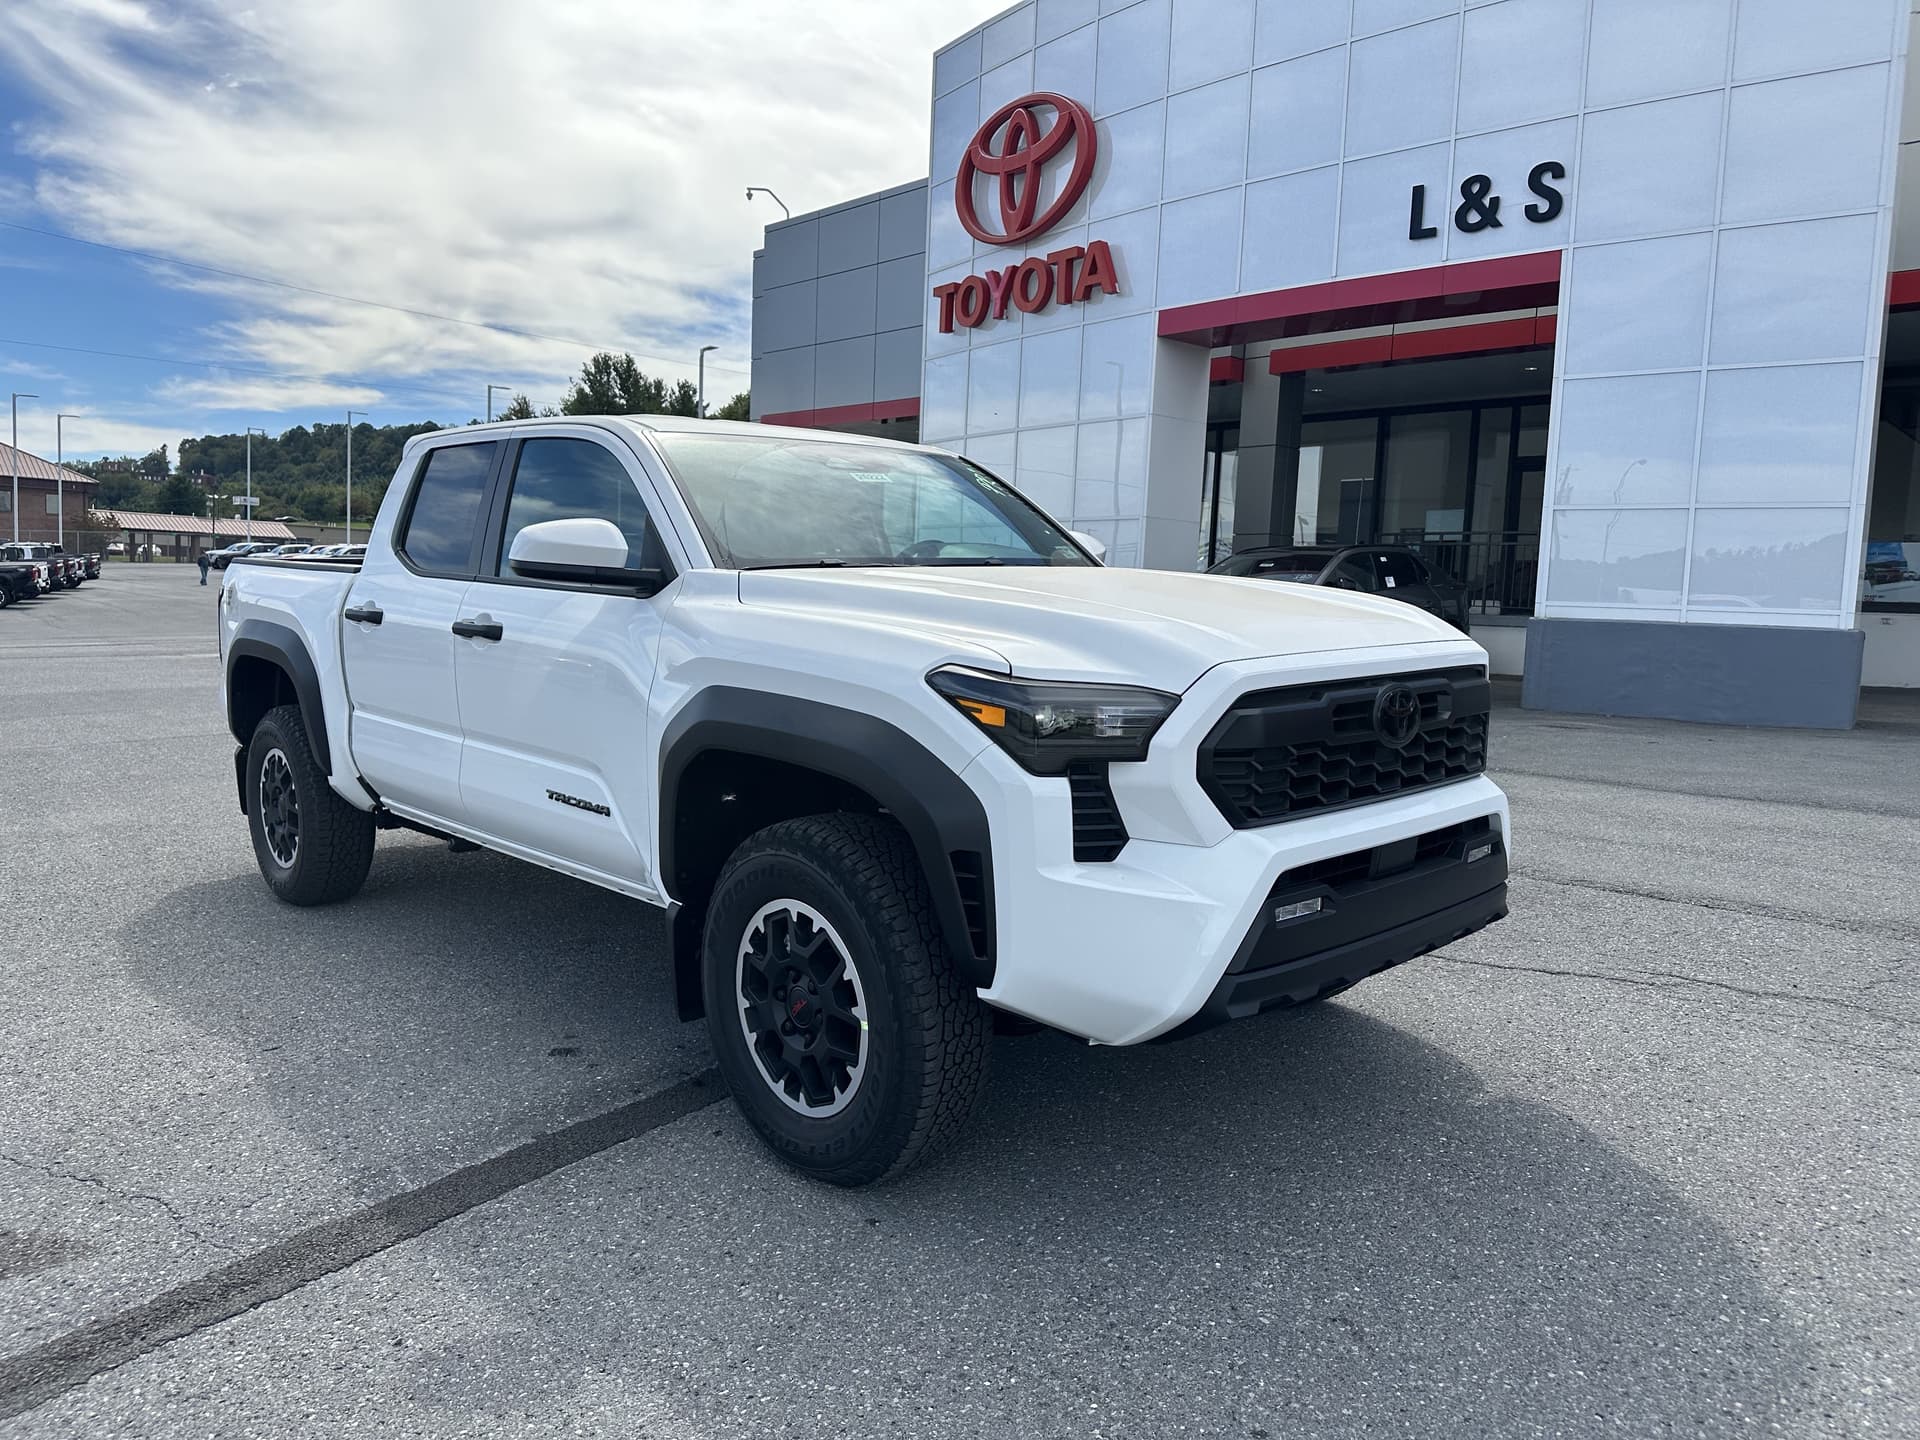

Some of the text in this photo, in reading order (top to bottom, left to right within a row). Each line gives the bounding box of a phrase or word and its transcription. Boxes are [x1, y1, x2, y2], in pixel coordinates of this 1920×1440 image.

[1409, 161, 1565, 240] L & S
[933, 240, 1119, 333] TOYOTA
[545, 789, 611, 817] TACOMA
